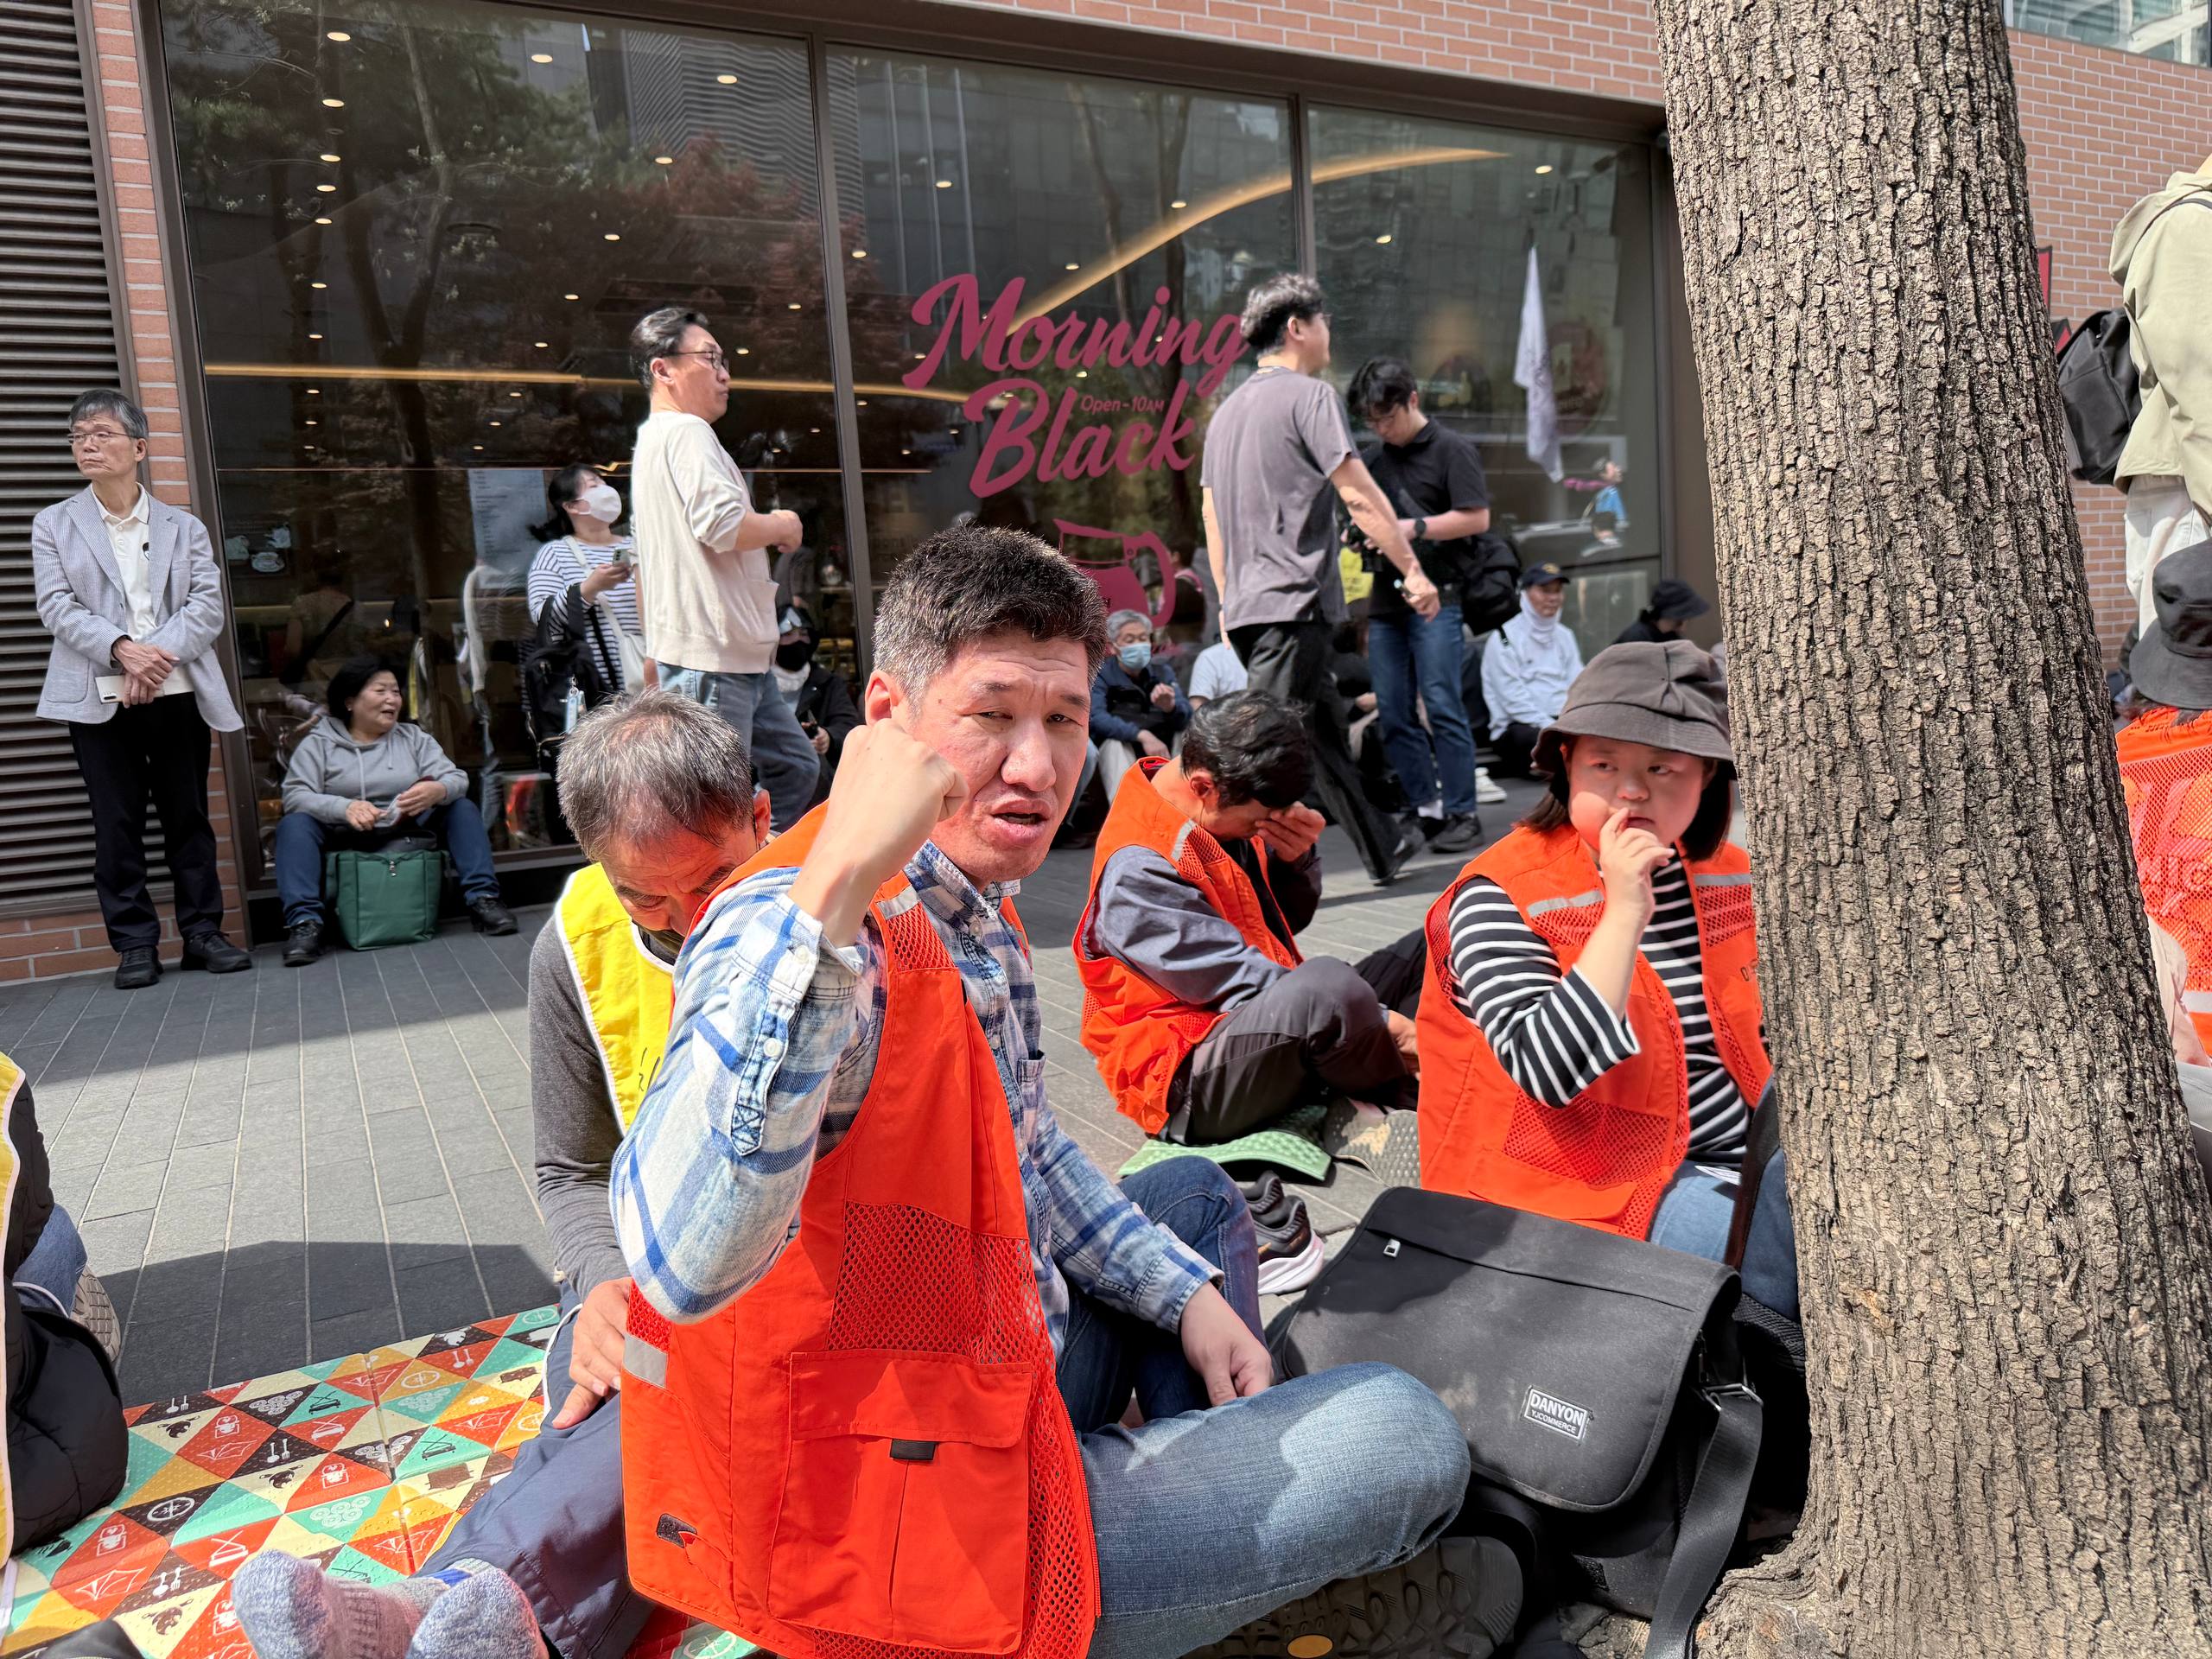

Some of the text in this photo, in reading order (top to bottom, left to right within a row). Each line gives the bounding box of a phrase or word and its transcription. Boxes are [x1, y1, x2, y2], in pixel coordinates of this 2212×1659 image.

[902, 273, 1249, 397] Morning
[963, 378, 1194, 498] Black
[1530, 1393, 1583, 1426] DANYON
